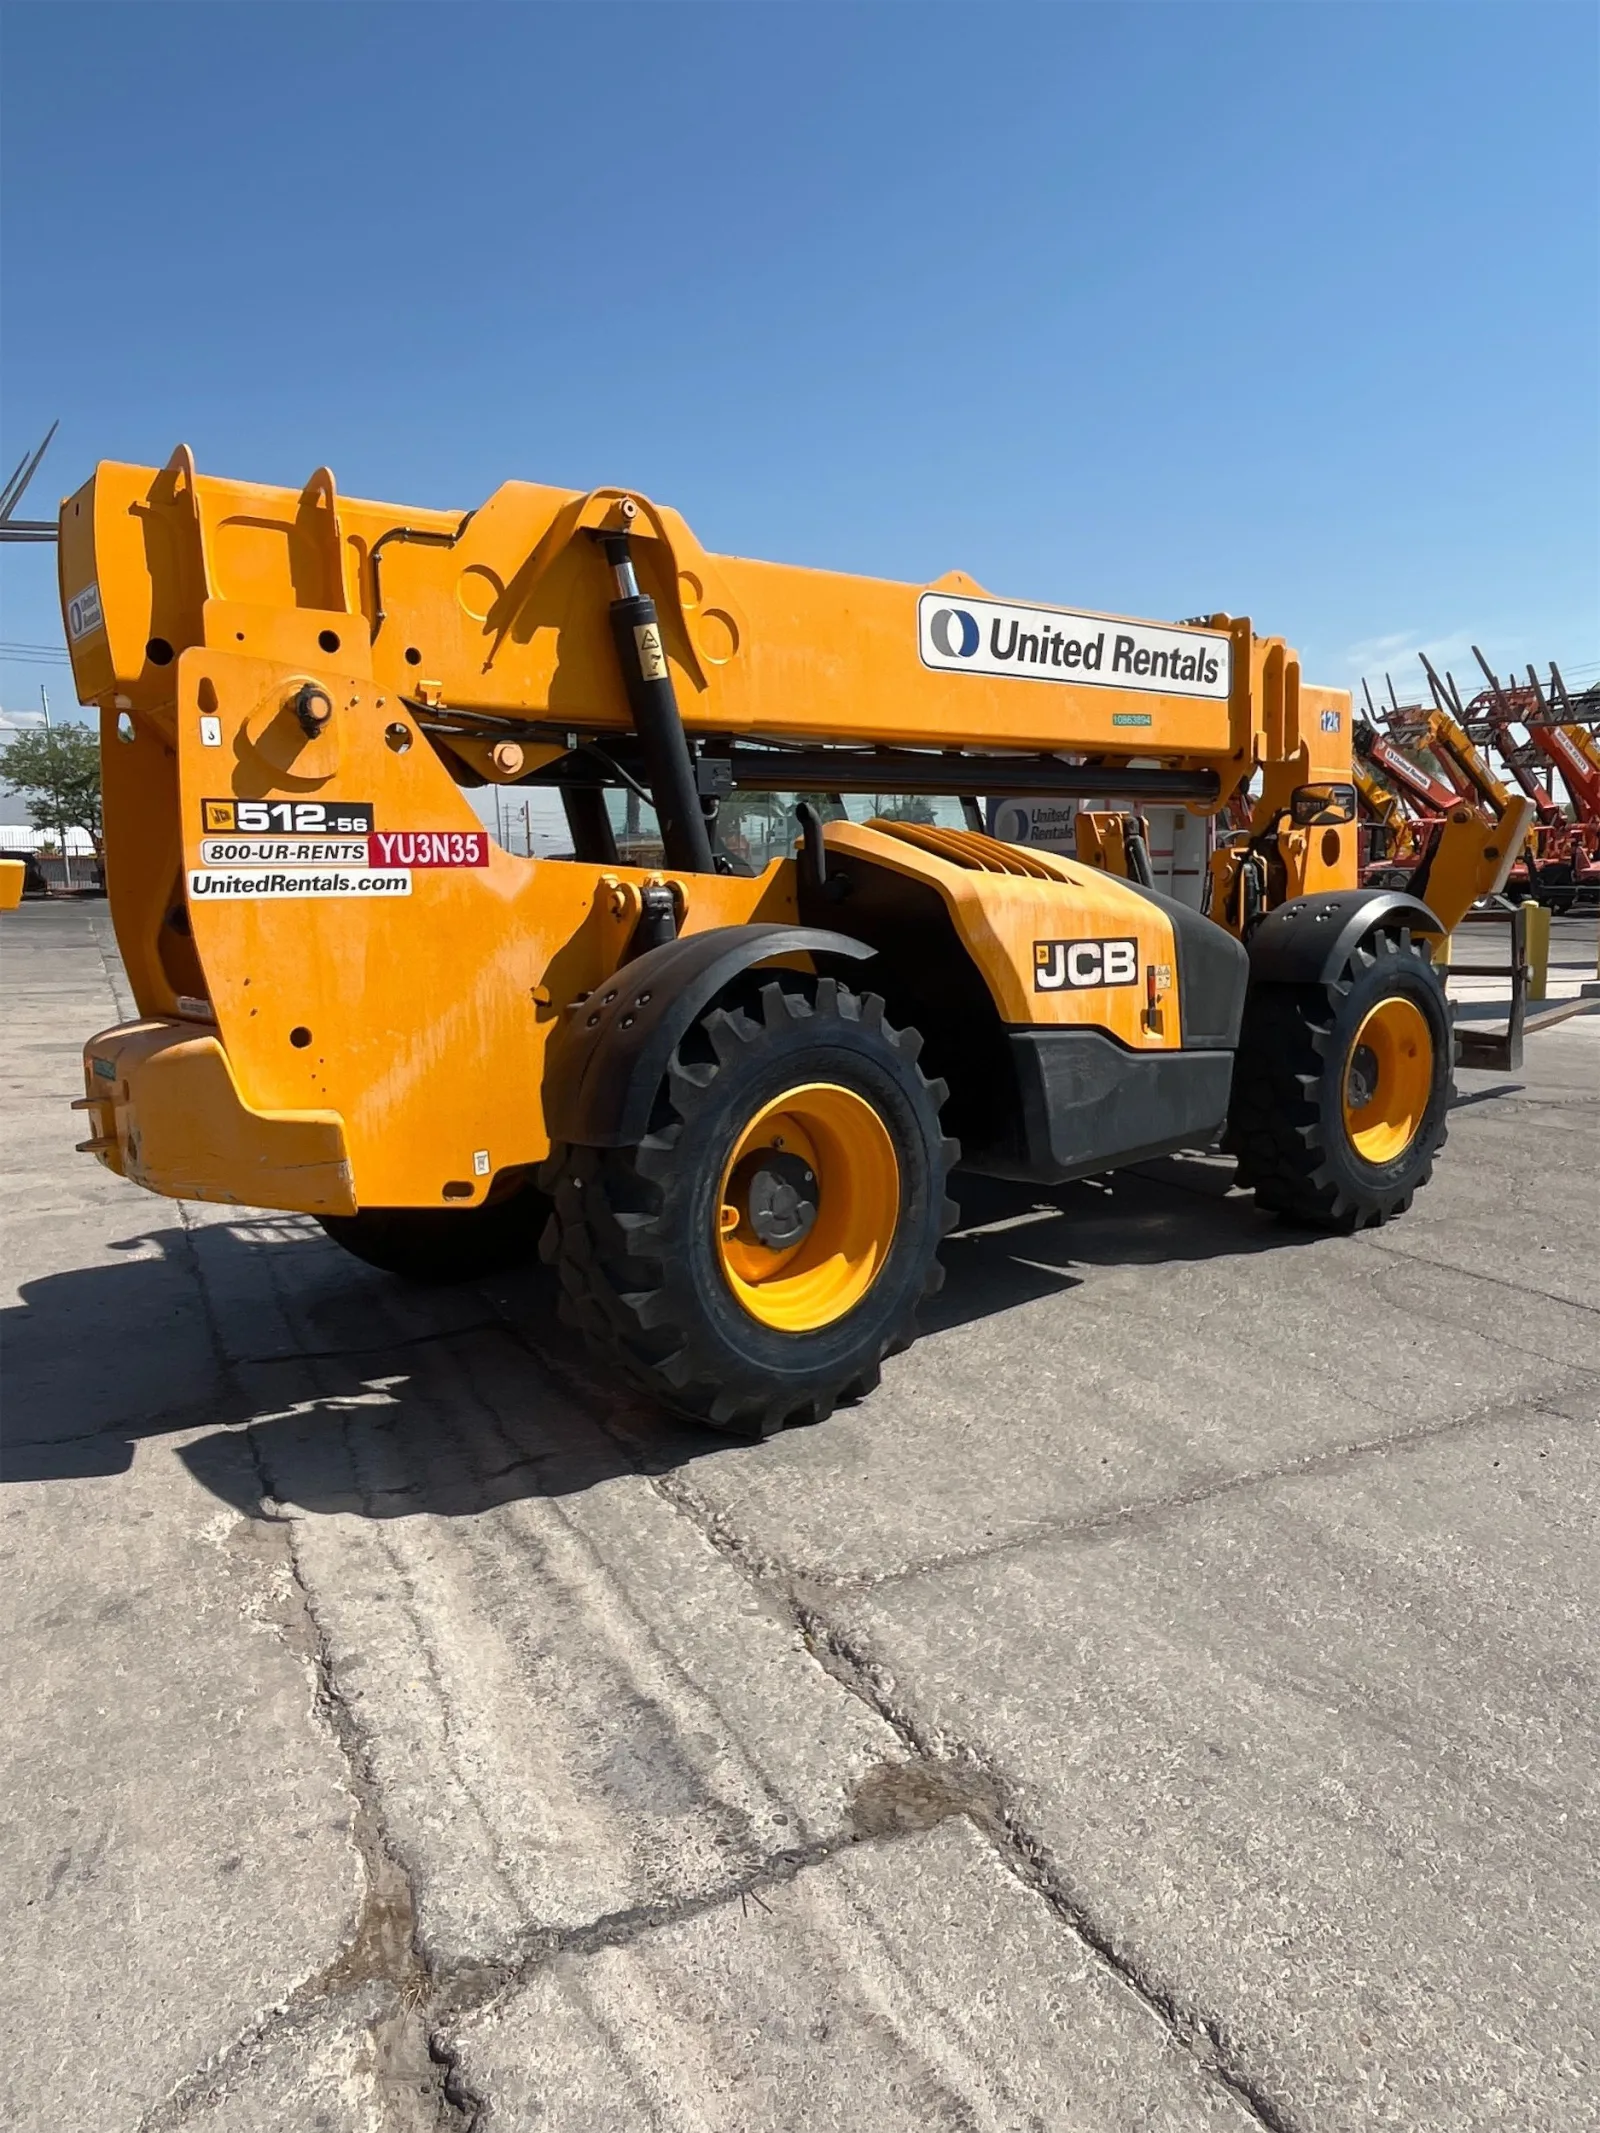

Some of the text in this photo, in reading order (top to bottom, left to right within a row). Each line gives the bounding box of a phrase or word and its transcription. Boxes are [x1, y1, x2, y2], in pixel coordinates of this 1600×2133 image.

[989, 618, 1219, 685] United Rentals
[1030, 805, 1074, 841] United Rentals
[211, 844, 365, 860] 800-UR-RENTS
[377, 833, 480, 864] YU3N35
[192, 873, 408, 894] UnitedRentals.com
[1036, 941, 1136, 988] JCB
